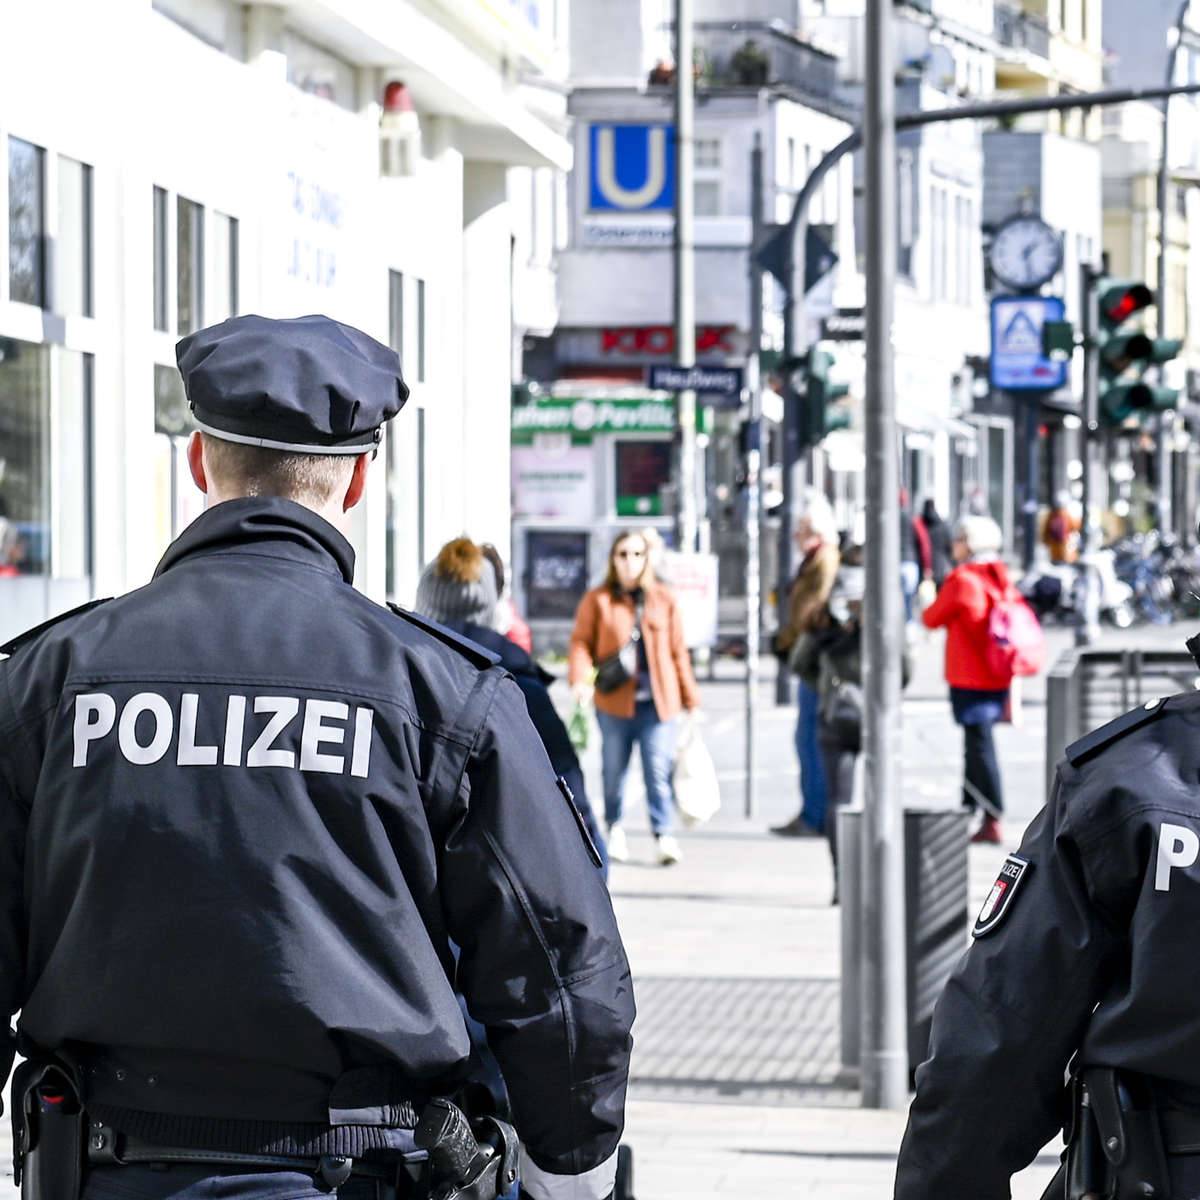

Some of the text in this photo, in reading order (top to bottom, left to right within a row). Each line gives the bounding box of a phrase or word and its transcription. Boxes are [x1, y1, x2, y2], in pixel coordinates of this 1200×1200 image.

[596, 127, 666, 209] U
[602, 326, 735, 353] KIOK
[73, 692, 374, 778] POLIZEI
